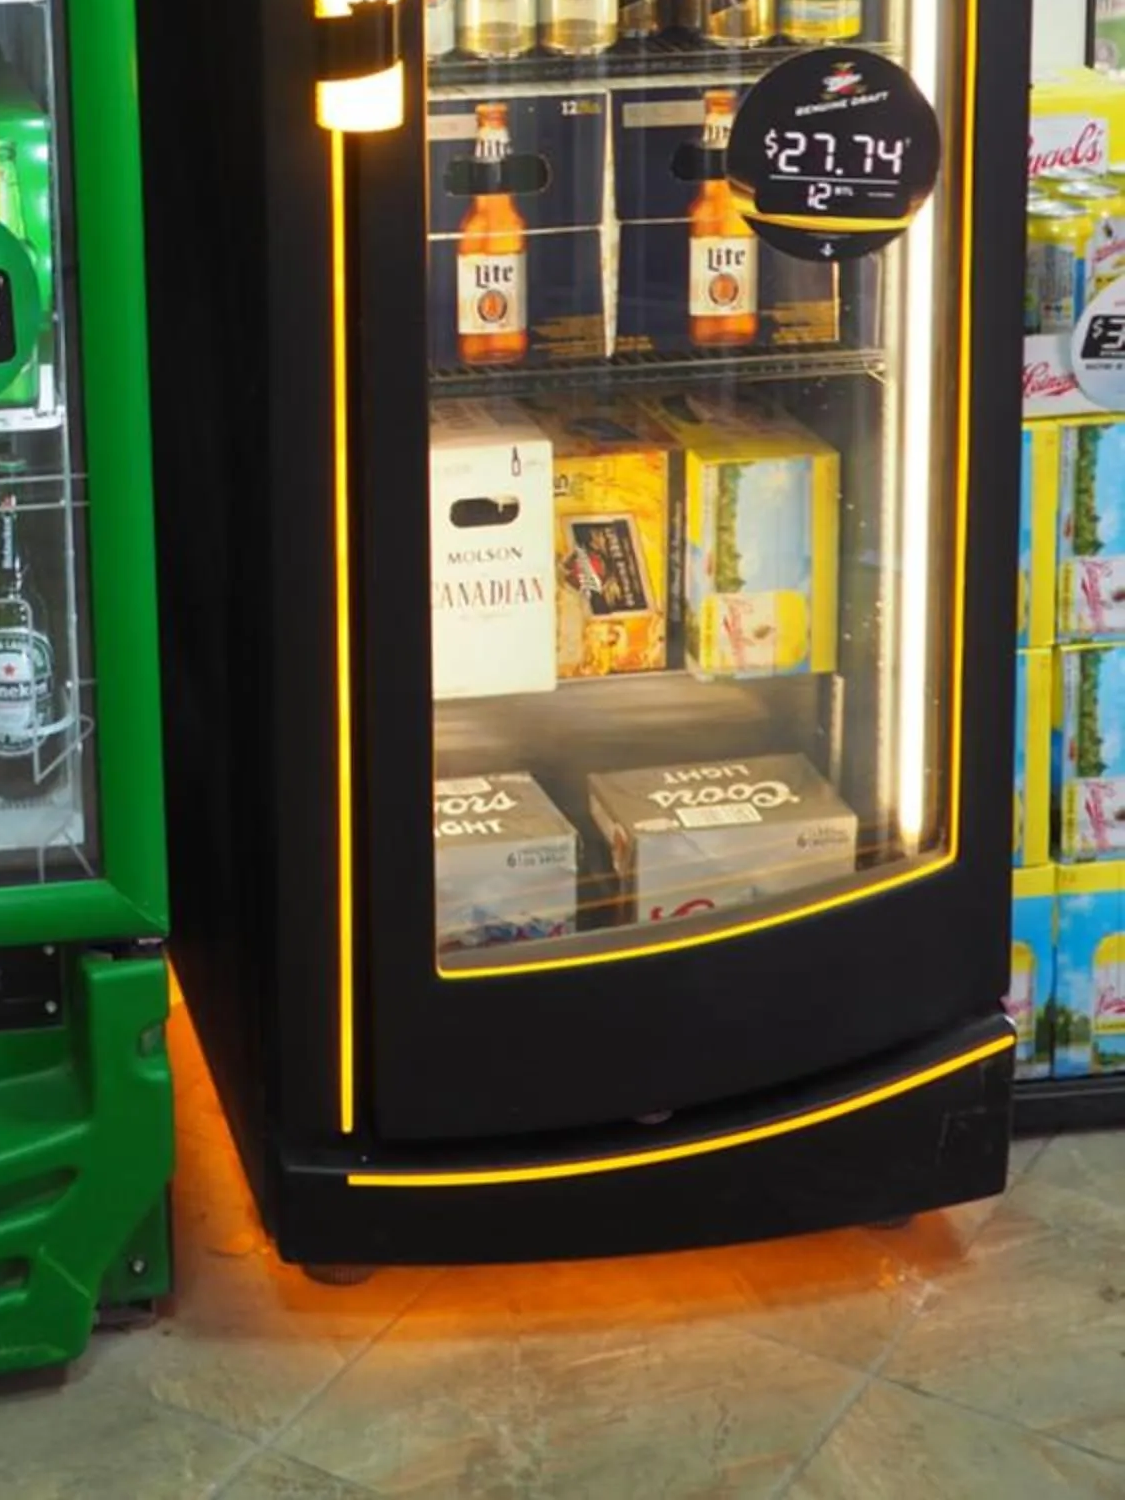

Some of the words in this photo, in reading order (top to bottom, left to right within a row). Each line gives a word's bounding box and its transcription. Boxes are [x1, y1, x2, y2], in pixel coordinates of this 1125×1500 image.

[561, 101, 577, 116] 12
[764, 127, 904, 176] $27.74
[807, 182, 832, 210] 12
[707, 247, 747, 273] Lite
[474, 264, 515, 289] Lite
[447, 546, 524, 566] MOLSON
[663, 764, 752, 785] LIGHT
[647, 780, 801, 809] Coors
